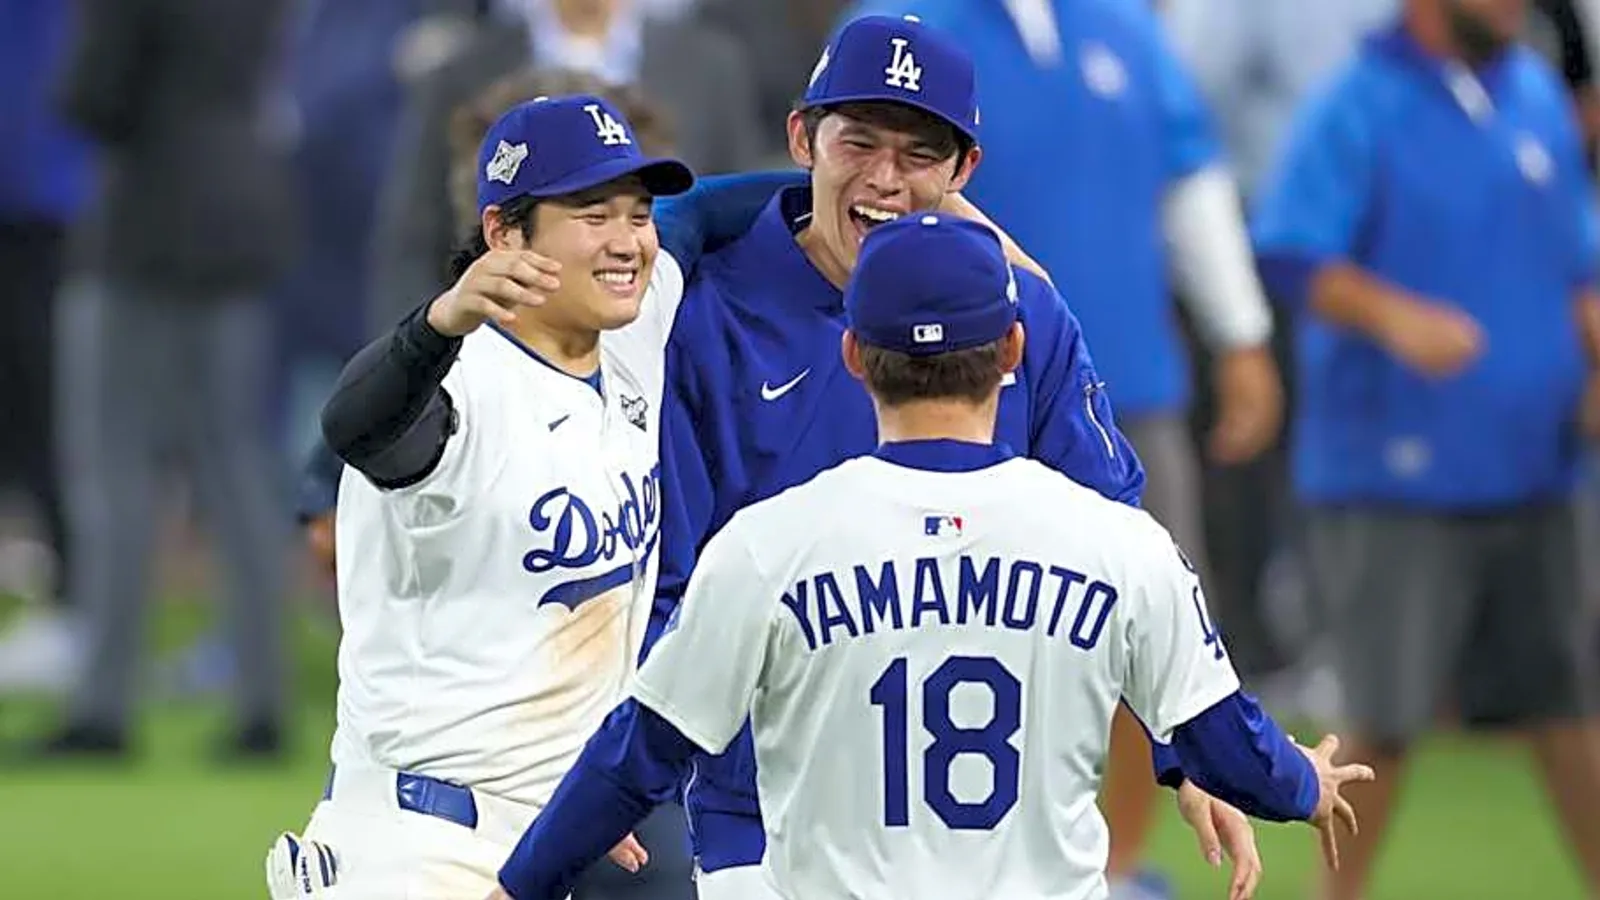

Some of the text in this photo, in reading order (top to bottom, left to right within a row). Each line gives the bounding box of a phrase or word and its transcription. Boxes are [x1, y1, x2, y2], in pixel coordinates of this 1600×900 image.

[885, 38, 922, 91] LA
[584, 104, 632, 145] LA
[780, 555, 1119, 652] YAMAMOTO
[869, 654, 1022, 831] 18
